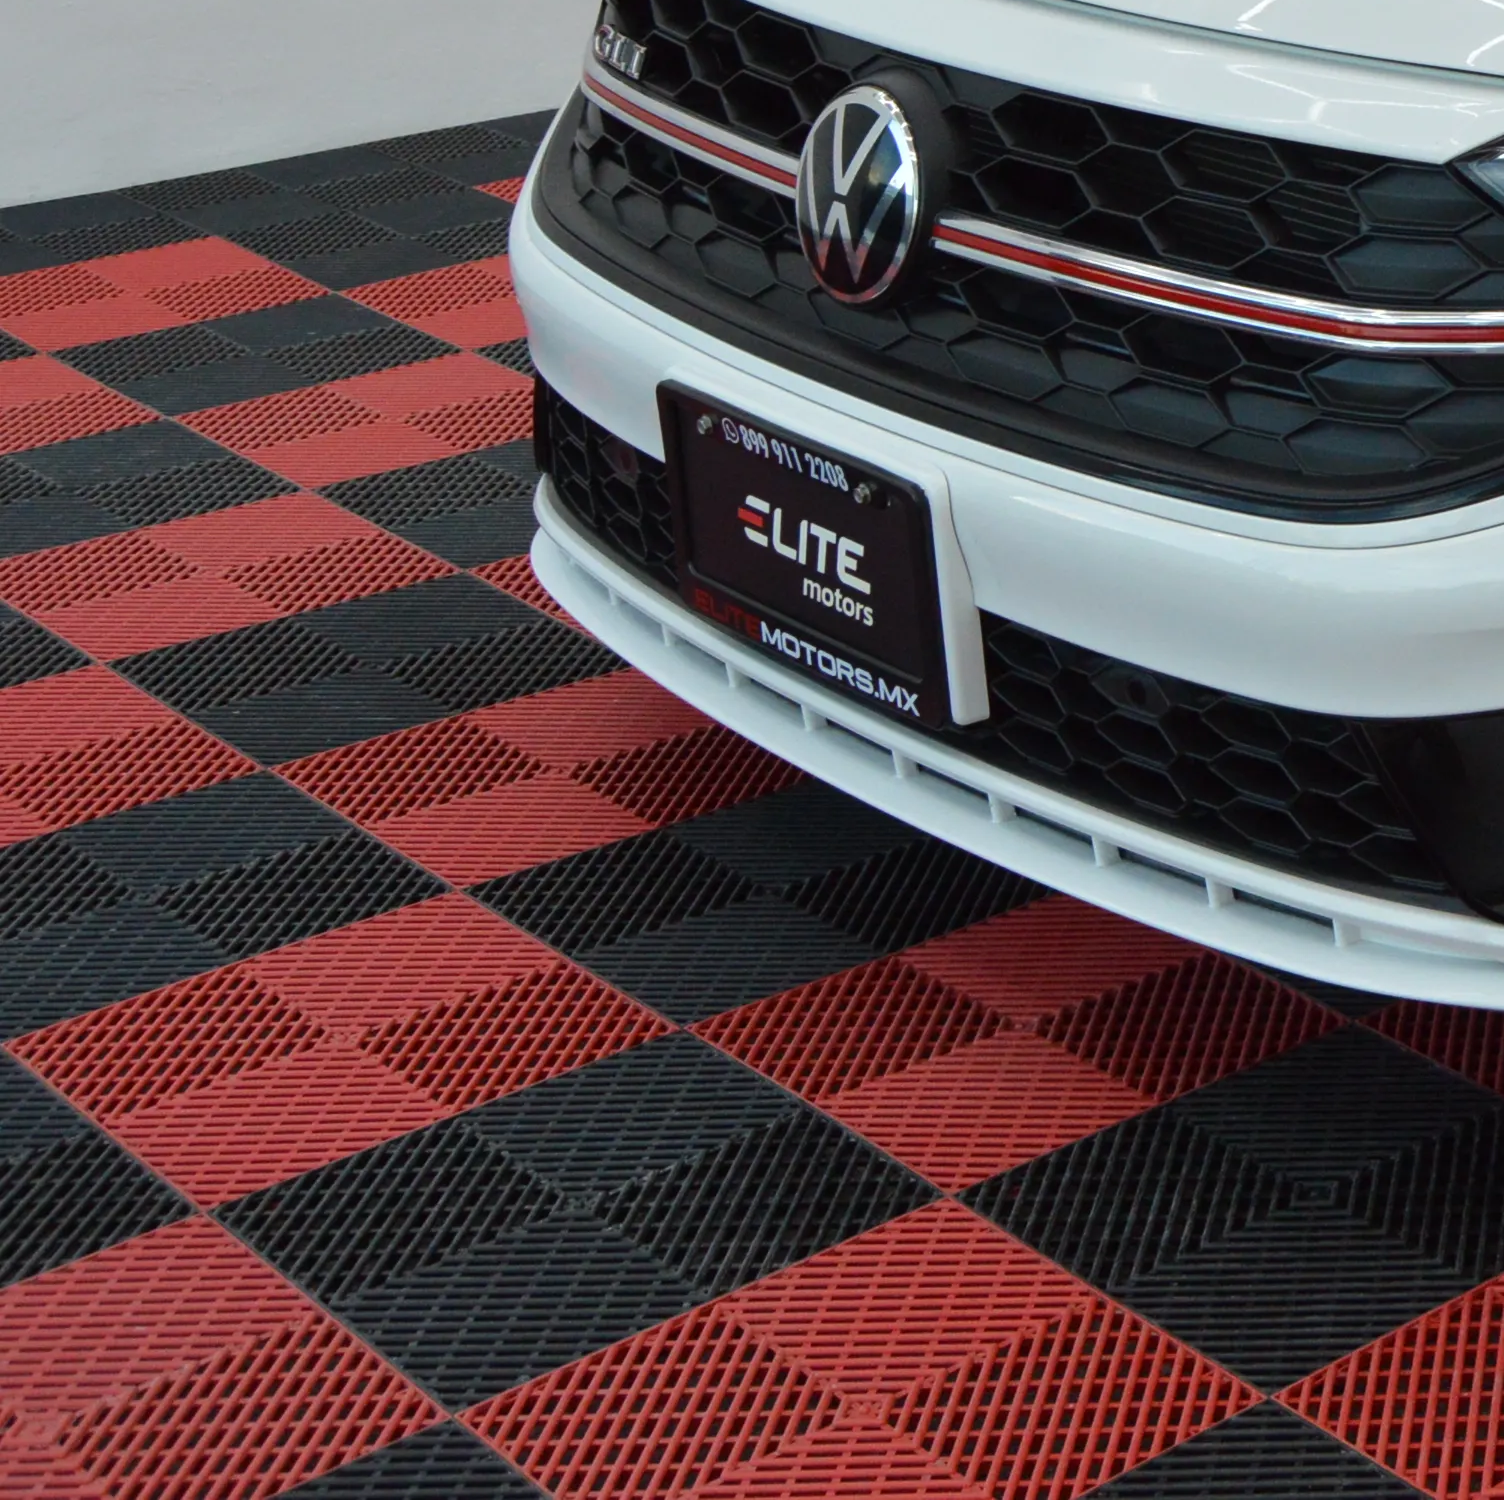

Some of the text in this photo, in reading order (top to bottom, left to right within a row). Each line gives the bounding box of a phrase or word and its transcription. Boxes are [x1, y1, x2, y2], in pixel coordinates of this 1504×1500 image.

[594, 24, 647, 80] GLI
[739, 424, 849, 492] 899 911 2208
[737, 494, 871, 595] ELITE
[803, 576, 874, 627] motors
